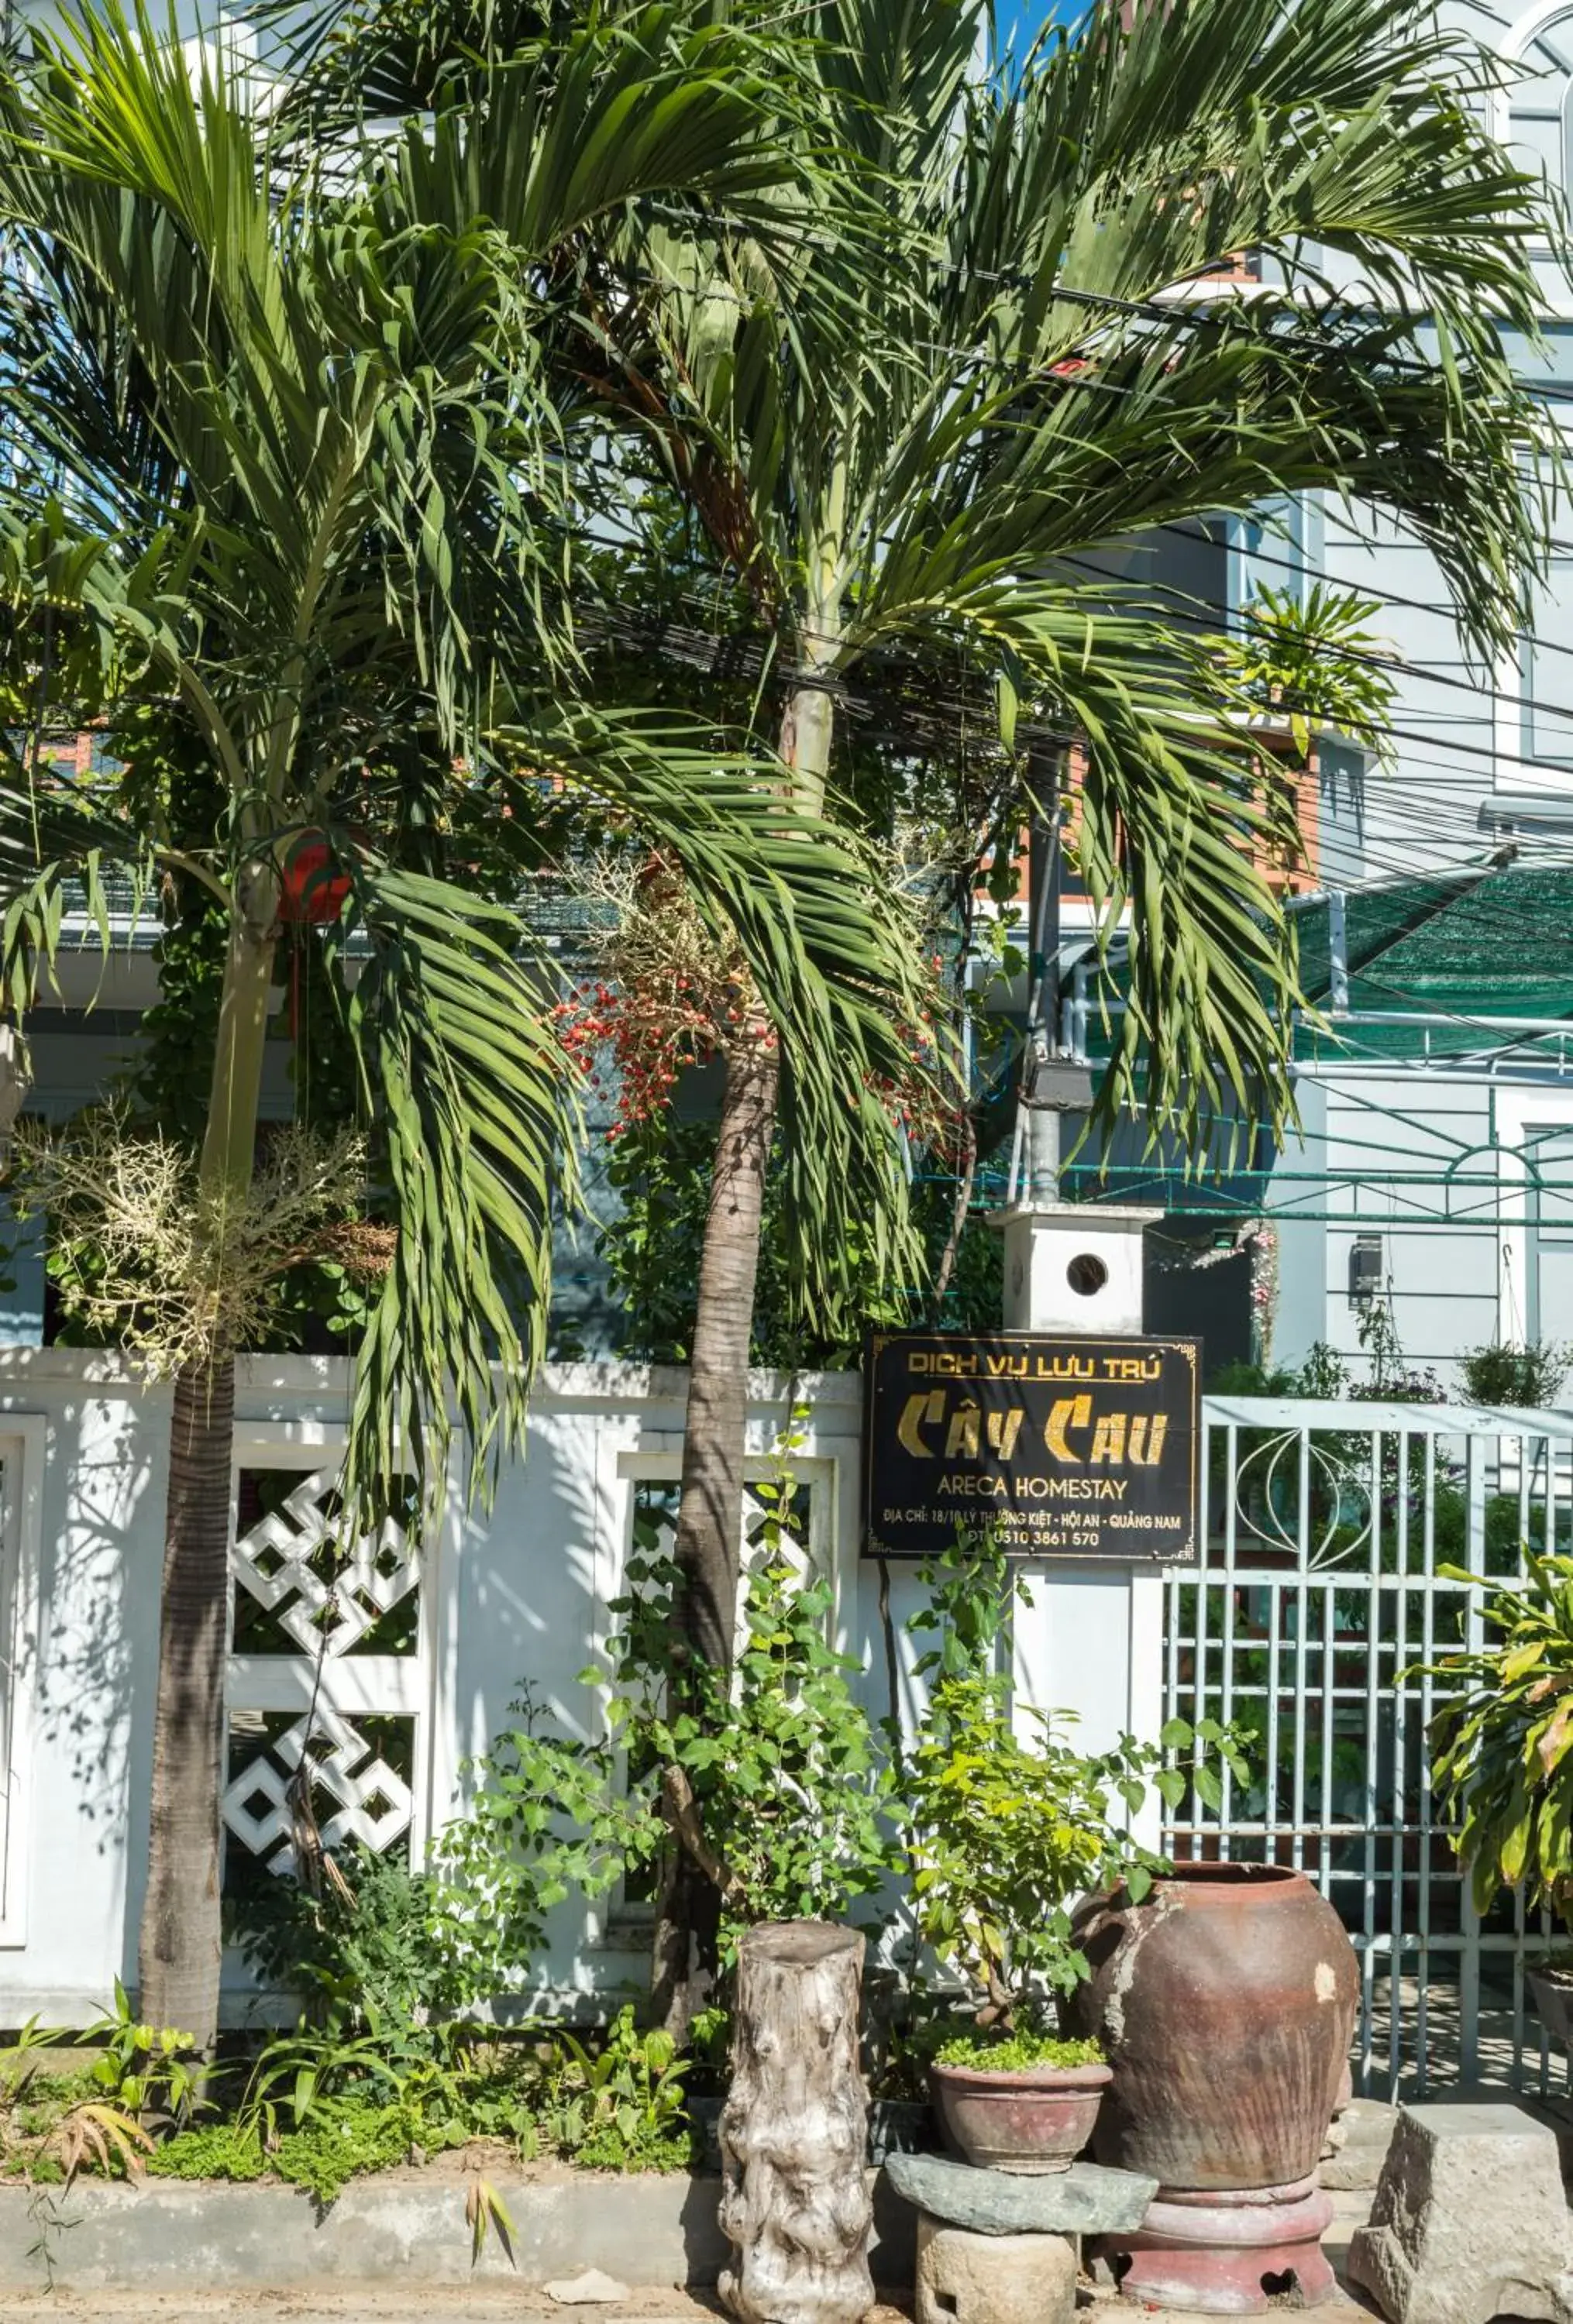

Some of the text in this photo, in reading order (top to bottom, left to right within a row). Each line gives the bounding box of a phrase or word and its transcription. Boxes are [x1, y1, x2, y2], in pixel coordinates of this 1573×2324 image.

[1037, 1353, 1096, 1377] LƯU
[1103, 1353, 1162, 1379] TRÚ
[897, 1389, 1169, 1465] CÂY CAU
[937, 1474, 1128, 1500] ARECA HOMESTAY
[883, 1508, 903, 1525] ĐỊA
[1028, 1508, 1052, 1528] KIỆT
[1061, 1509, 1081, 1530] HỘI
[1083, 1514, 1100, 1528] AN
[1109, 1510, 1153, 1529] QUẢNG
[1154, 1515, 1182, 1530] NAM
[1032, 1531, 1067, 1545] 3861
[1072, 1532, 1100, 1545] 570
